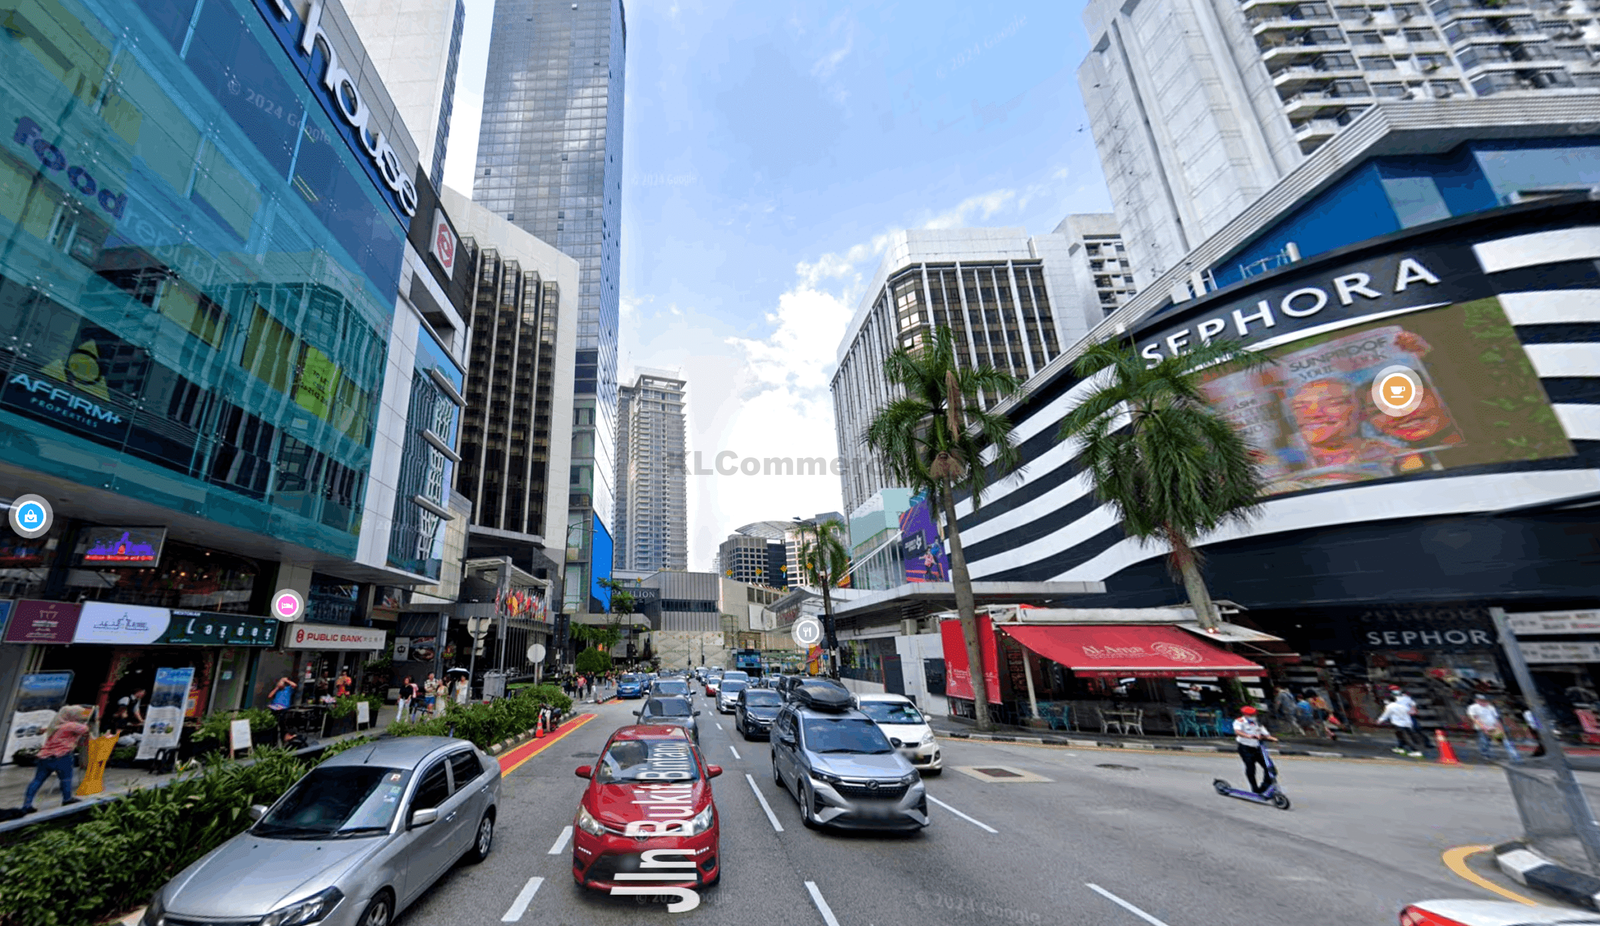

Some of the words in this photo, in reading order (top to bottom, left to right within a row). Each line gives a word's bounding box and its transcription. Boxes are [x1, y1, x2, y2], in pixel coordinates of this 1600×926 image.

[302, 0, 418, 217] house
[1140, 257, 1441, 370] SEPHORA
[1289, 337, 1388, 373] SUNPROOF
[9, 373, 122, 425] AFFIRM+
[30, 396, 98, 428] PROPERTIES
[307, 632, 338, 642] PUBLIC
[340, 634, 362, 643] BANK
[1366, 629, 1493, 645] SEPHOR
